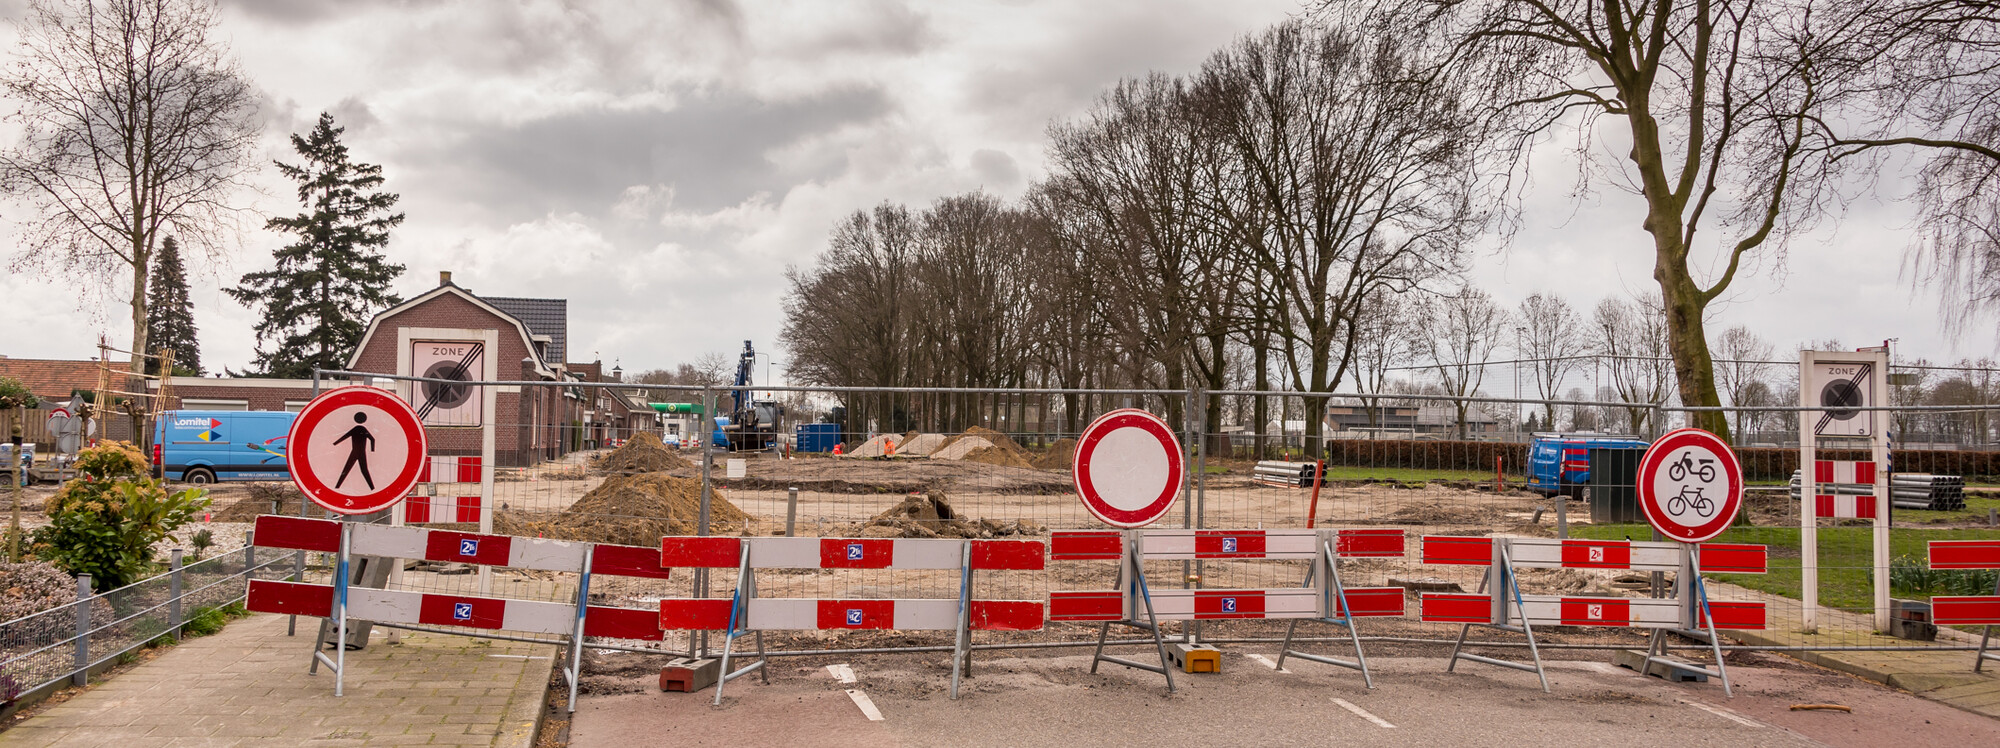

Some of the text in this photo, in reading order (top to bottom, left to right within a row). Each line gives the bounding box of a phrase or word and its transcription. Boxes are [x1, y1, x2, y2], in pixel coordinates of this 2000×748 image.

[432, 347, 464, 356] ZONE
[1828, 367, 1855, 375] ZONE
[174, 417, 210, 426] Lomitel
